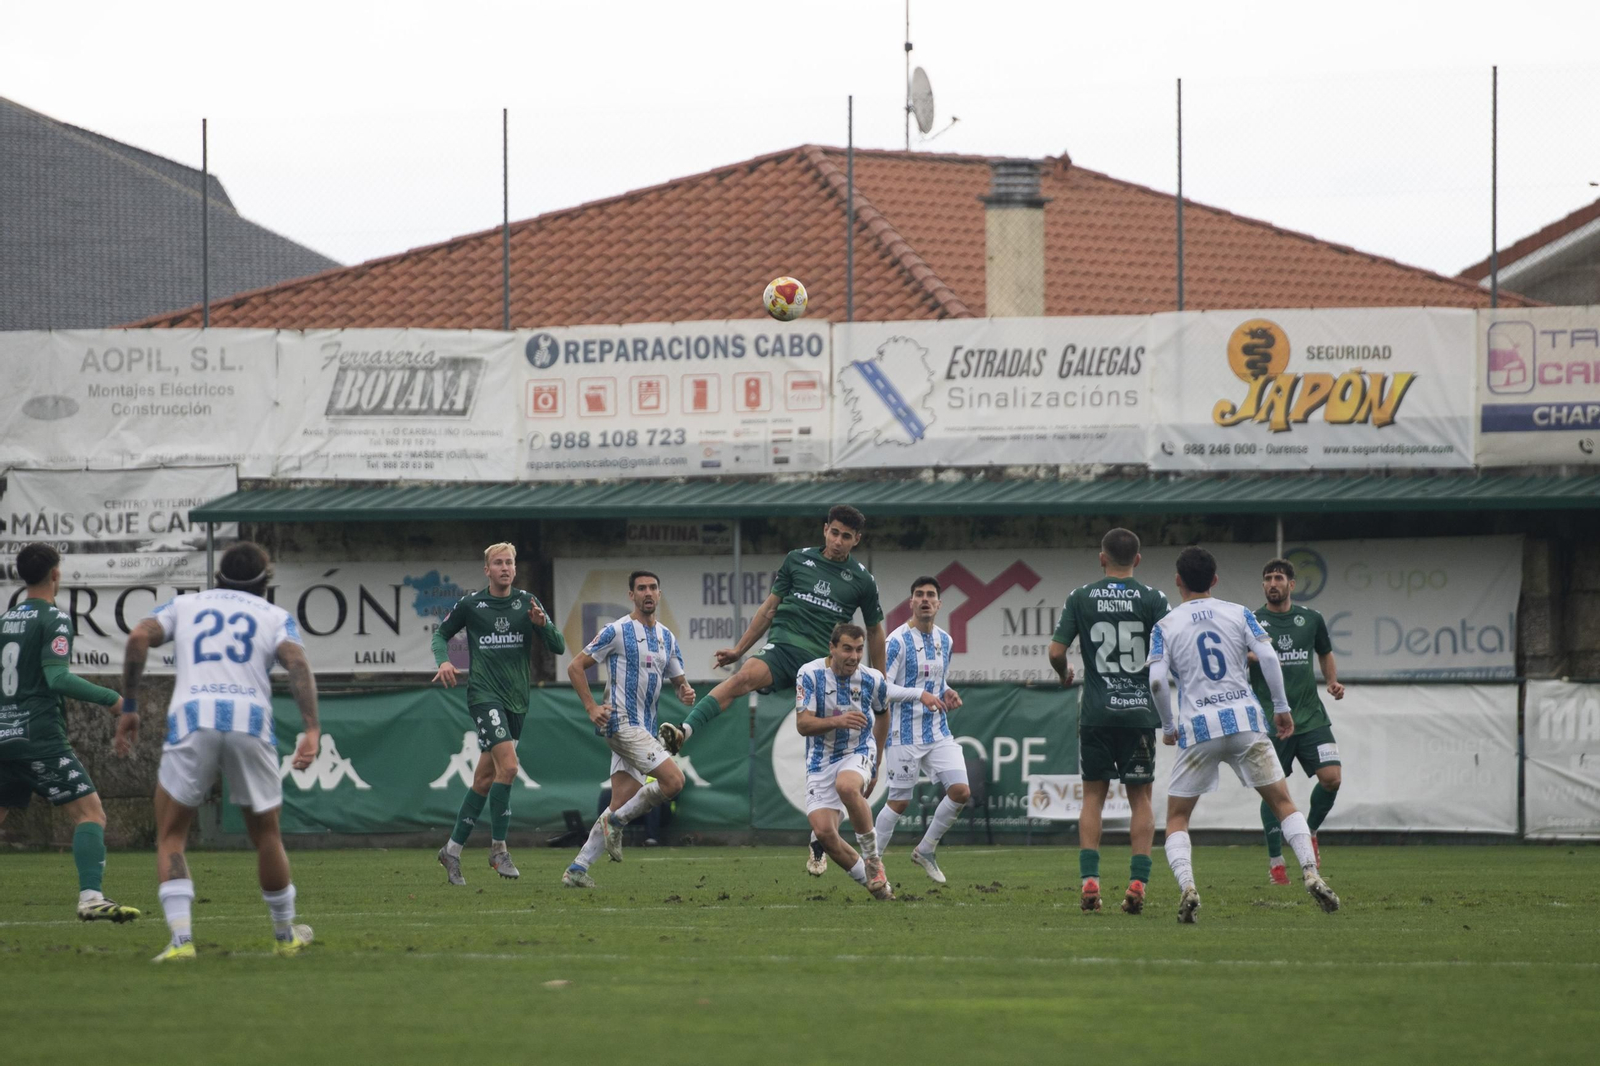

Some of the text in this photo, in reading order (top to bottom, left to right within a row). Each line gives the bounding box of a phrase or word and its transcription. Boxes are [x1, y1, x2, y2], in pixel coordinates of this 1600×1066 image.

[320, 340, 437, 370] Ferraxería
[564, 332, 823, 364] REPARACIONS CABO
[1306, 344, 1392, 361] SEGURIDAD
[80, 346, 244, 375] AOPIL, S.L.
[1538, 361, 1600, 385] CA
[88, 382, 235, 400] Montajes Eléctricos
[334, 369, 471, 410] BOTANA
[947, 384, 1139, 409] Sinalizacións
[1212, 366, 1419, 433] JAPÓN
[111, 401, 212, 417] Construcción
[1532, 404, 1600, 426] CHAP
[550, 428, 687, 449] 988 108 723
[1183, 443, 1206, 456] 988
[1209, 443, 1231, 455] 246
[1234, 443, 1257, 455] 000
[1266, 443, 1308, 454] Ourense
[1323, 442, 1454, 456] www.seguridadjapon.com
[526, 455, 688, 471] reparacionscabo@gmail.com
[11, 507, 74, 536] MÁIS
[83, 511, 139, 538] QUE
[627, 524, 699, 542] CANTINA
[1344, 561, 1447, 598] Gupo
[1097, 600, 1133, 612] BASTIDA
[1192, 610, 1213, 623] PITU
[194, 608, 258, 664] 23
[479, 631, 524, 645] columbia
[690, 617, 733, 639] PEDRO
[1374, 611, 1515, 656] Dental
[69, 650, 109, 665] LLIÑO
[355, 648, 396, 664] LALÍN
[1090, 621, 1147, 674] 25
[1196, 631, 1227, 681] 6
[1278, 648, 1309, 661] umbia
[2, 641, 20, 697] 8
[190, 684, 257, 697] SASEGUR
[1195, 689, 1249, 708] SASEGUR
[1110, 696, 1148, 707] Bopeixe
[489, 708, 501, 726] 3
